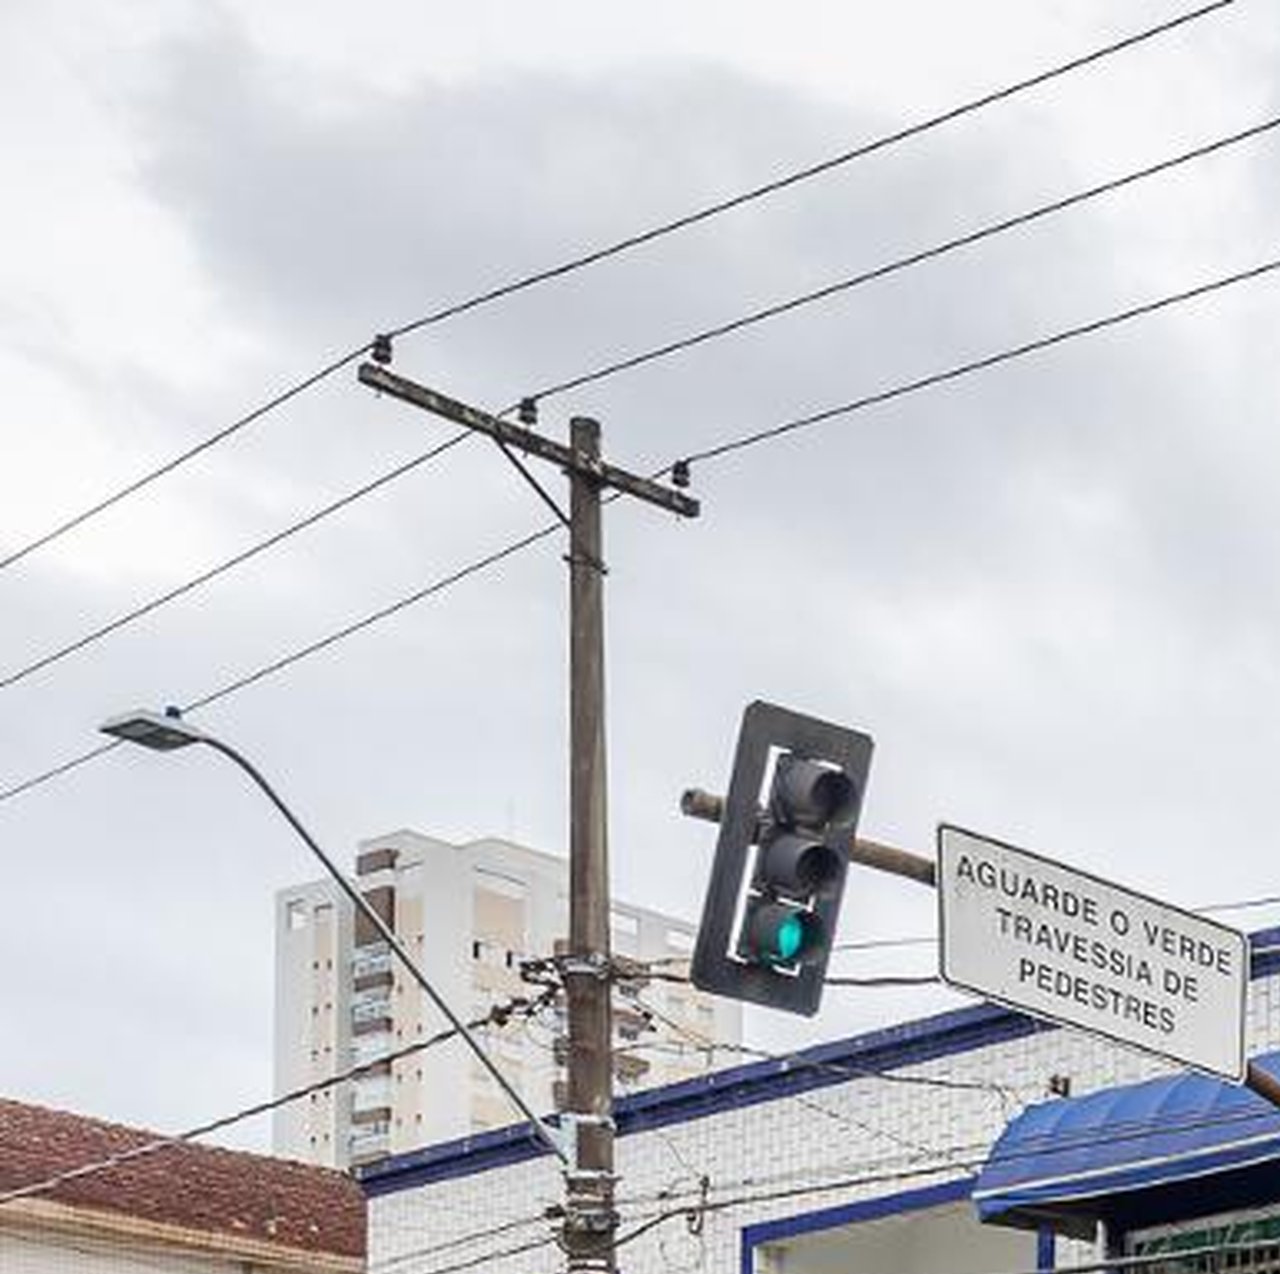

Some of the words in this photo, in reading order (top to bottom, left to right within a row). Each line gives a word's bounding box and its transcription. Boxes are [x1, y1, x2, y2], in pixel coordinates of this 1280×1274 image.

[956, 855, 1099, 926] AGUARDE
[1109, 910, 1130, 937] O
[1143, 920, 1232, 976] VERDE
[995, 907, 1152, 987] TRAVESSIA
[1163, 970, 1199, 1002] DE
[1019, 958, 1176, 1034] PEDESTRES
